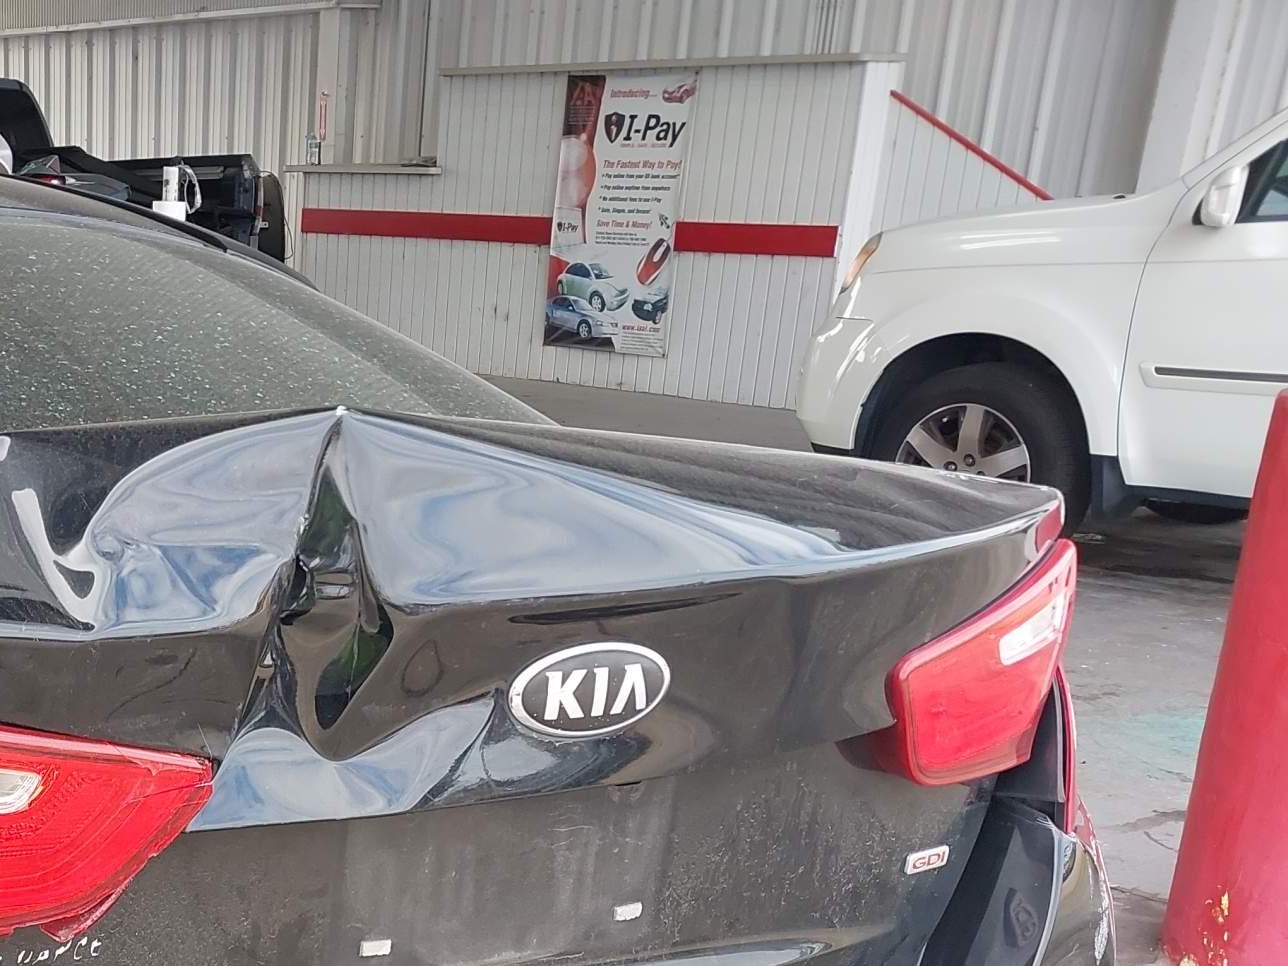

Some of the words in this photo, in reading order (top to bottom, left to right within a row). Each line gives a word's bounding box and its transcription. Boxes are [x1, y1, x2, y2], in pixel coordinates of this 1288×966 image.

[622, 114, 686, 148] I-Pay
[603, 160, 615, 168] The
[616, 160, 641, 168] Fastest
[642, 160, 656, 170] Way
[657, 160, 664, 168] to
[597, 219, 610, 227] Save
[611, 220, 624, 228] Time
[543, 663, 648, 721] KIA
[912, 850, 946, 870] GDI
